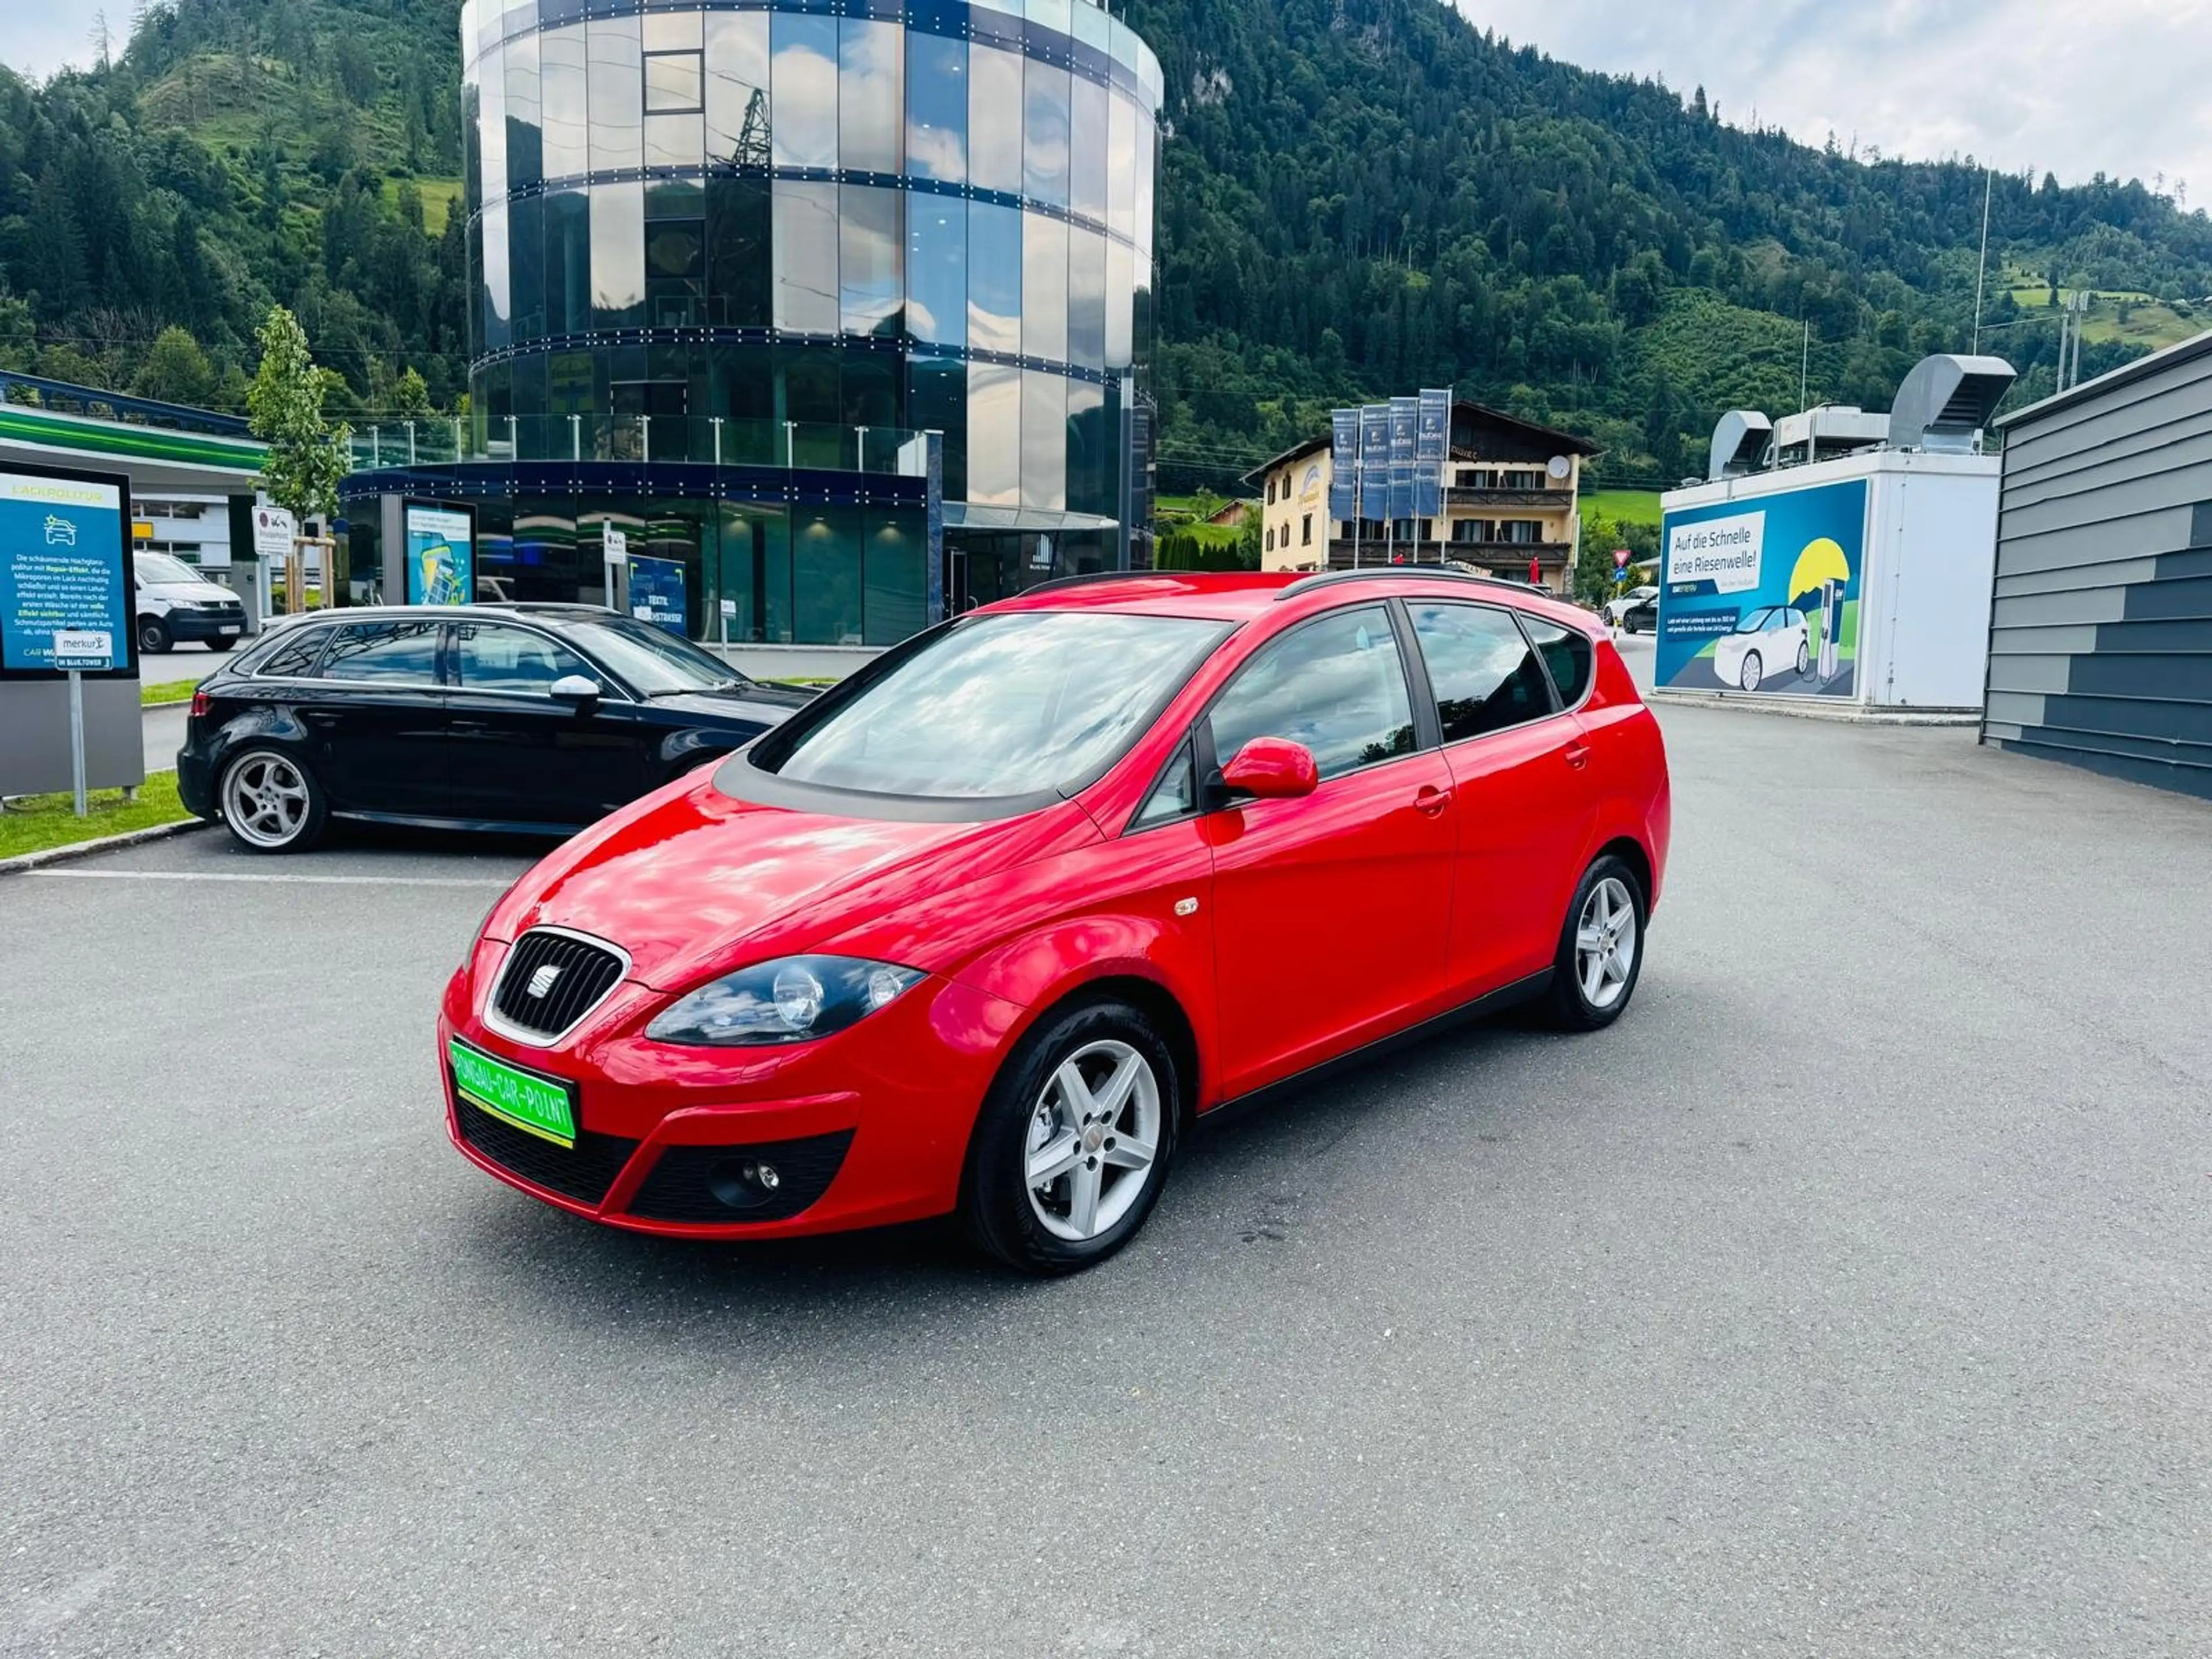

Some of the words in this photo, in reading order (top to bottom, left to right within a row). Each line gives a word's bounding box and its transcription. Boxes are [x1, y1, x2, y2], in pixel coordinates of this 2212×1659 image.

[1675, 533, 1692, 551] Auf
[1694, 533, 1707, 549] die
[1709, 527, 1751, 547] Schnelle
[1674, 559, 1692, 574] eine
[1695, 550, 1756, 572] Riesenwelle!
[63, 639, 95, 648] merkur
